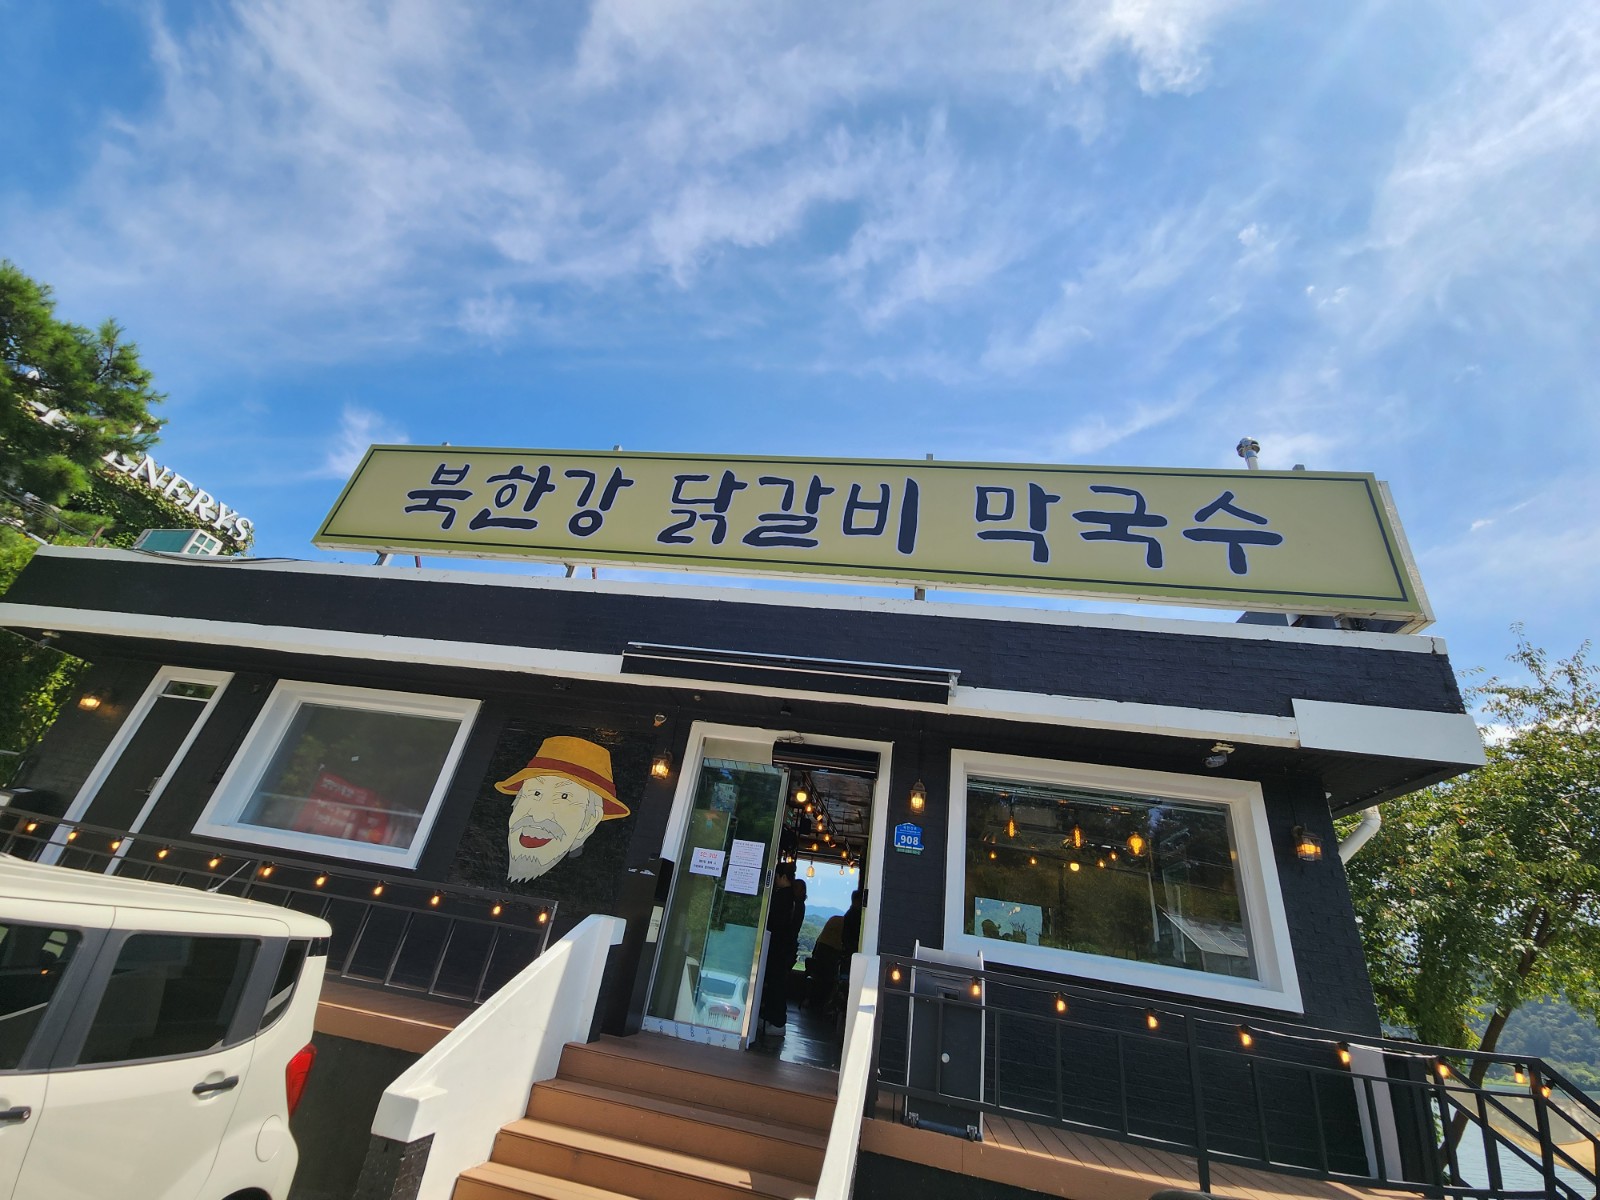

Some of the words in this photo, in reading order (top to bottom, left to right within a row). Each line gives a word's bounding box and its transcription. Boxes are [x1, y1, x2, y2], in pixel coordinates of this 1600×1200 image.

[404, 463, 635, 537] 북한강
[656, 472, 919, 555] 닭갈비
[975, 482, 1283, 575] 막국수
[900, 834, 919, 846] 908
